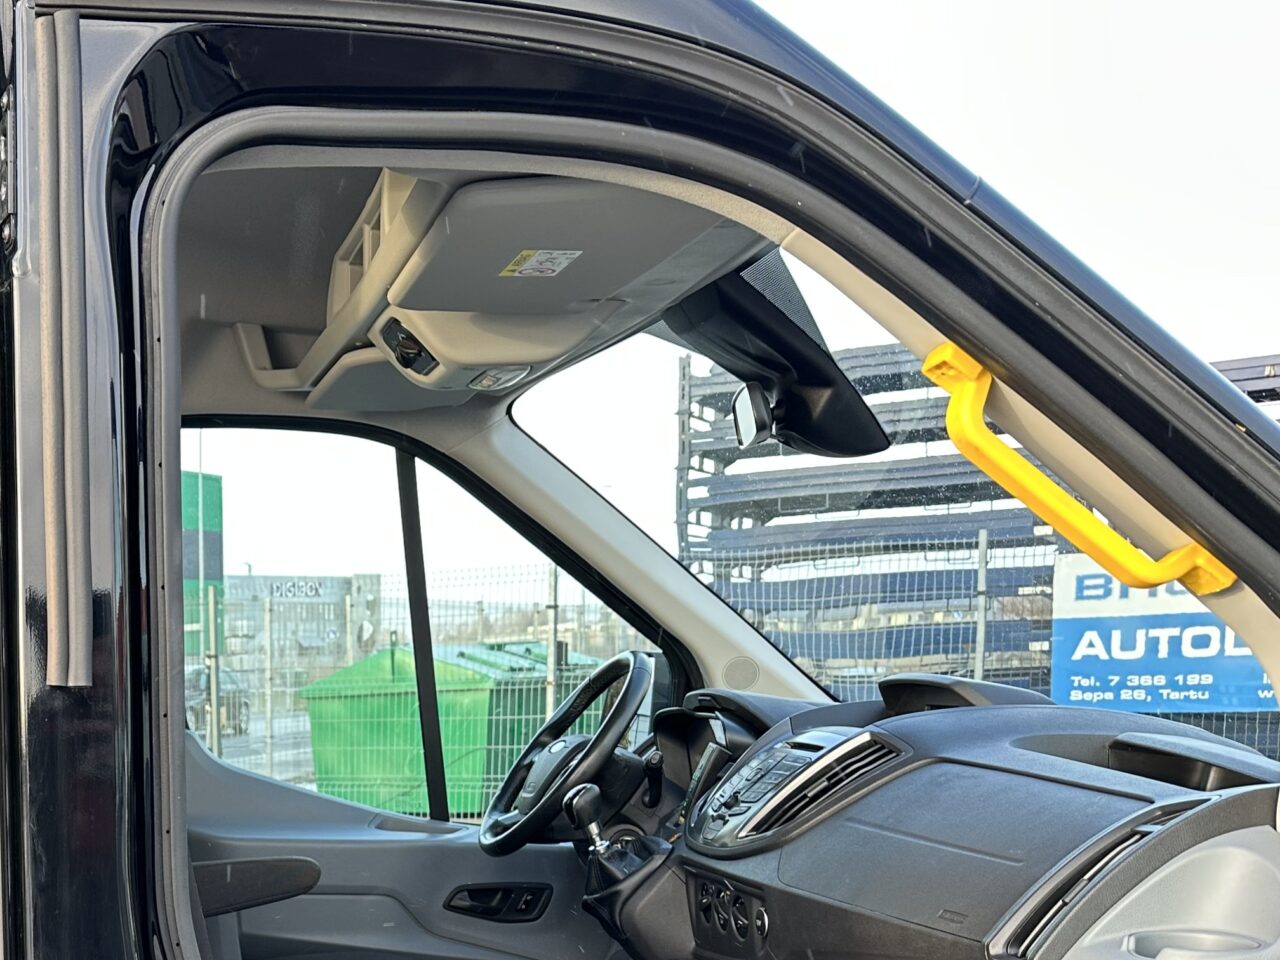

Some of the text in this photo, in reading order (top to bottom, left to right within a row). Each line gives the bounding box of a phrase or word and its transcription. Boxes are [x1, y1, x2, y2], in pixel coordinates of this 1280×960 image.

[1070, 673, 1214, 687] Tel. 7 366 199
[1069, 688, 1210, 703] Sepa 26, Tartu
